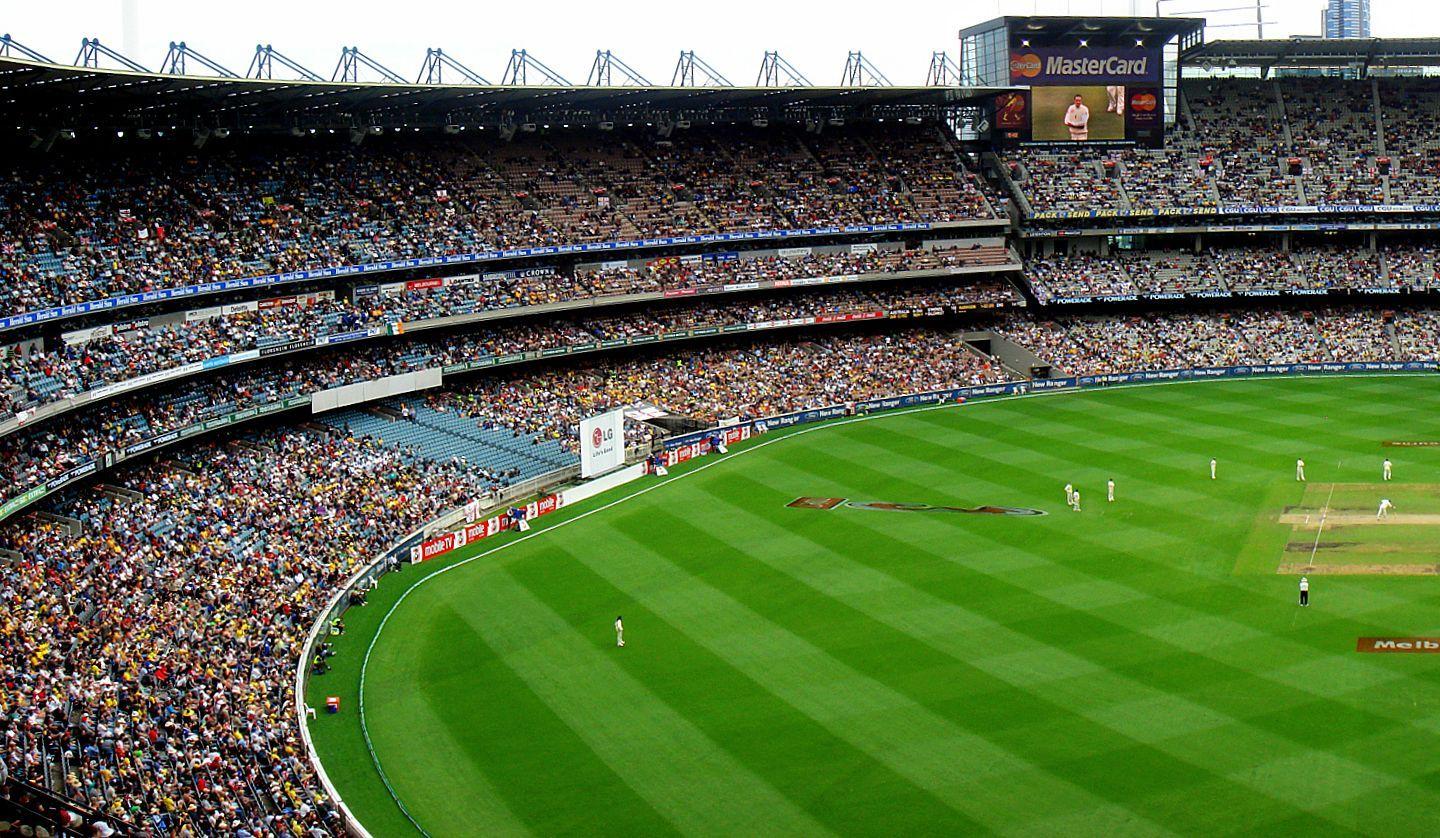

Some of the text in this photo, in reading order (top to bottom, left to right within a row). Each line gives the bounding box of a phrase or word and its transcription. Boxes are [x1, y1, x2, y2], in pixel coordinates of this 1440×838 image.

[1046, 56, 1146, 74] MasterCard
[603, 428, 613, 441] LG
[540, 498, 554, 510] mobile
[468, 524, 484, 538] mobile
